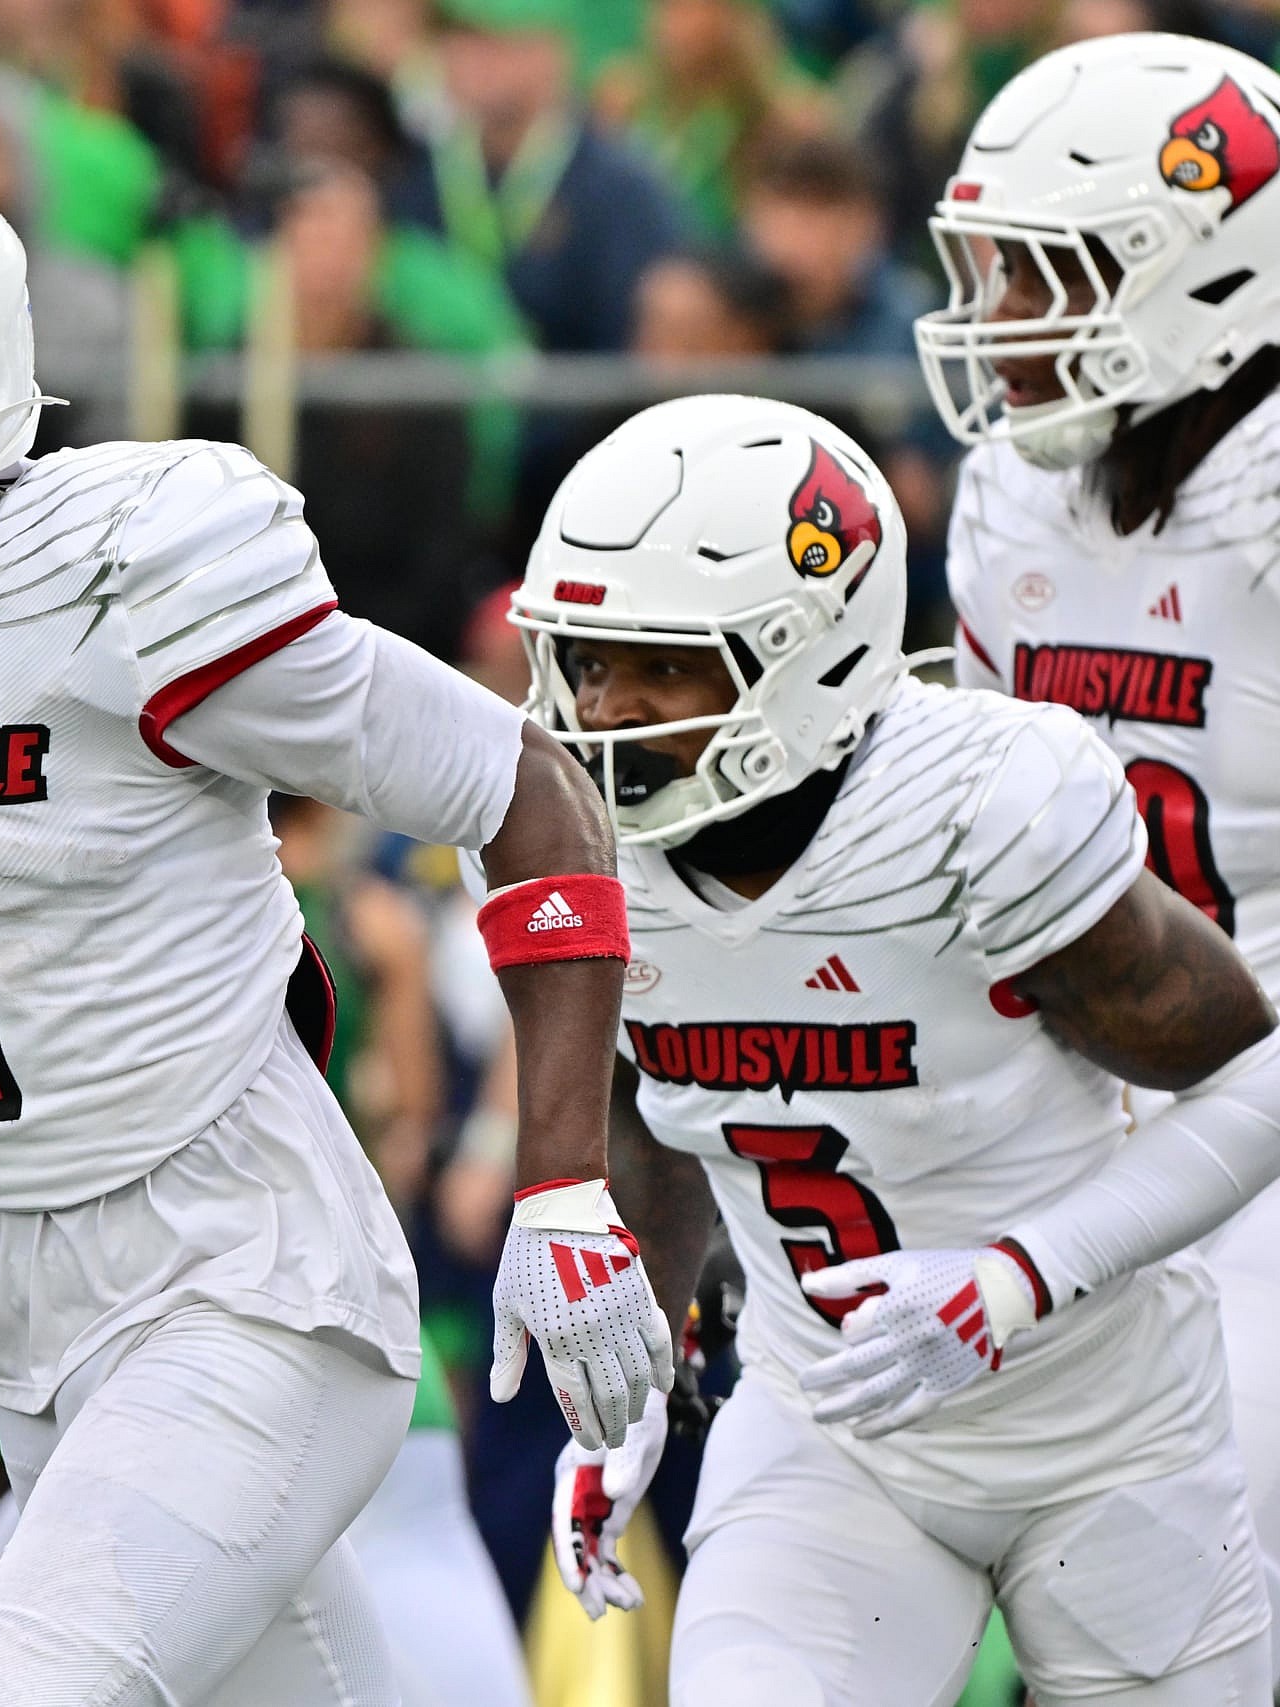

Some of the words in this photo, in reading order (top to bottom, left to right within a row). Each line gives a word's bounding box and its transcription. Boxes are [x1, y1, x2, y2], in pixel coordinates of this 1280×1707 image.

[554, 579, 607, 606] CARDS
[1014, 643, 1211, 729] LOUISVILLE
[527, 914, 583, 932] adidas
[624, 1020, 919, 1096] LOUISVILLE
[721, 1123, 903, 1331] 3
[557, 1387, 582, 1431] ADIZERO
